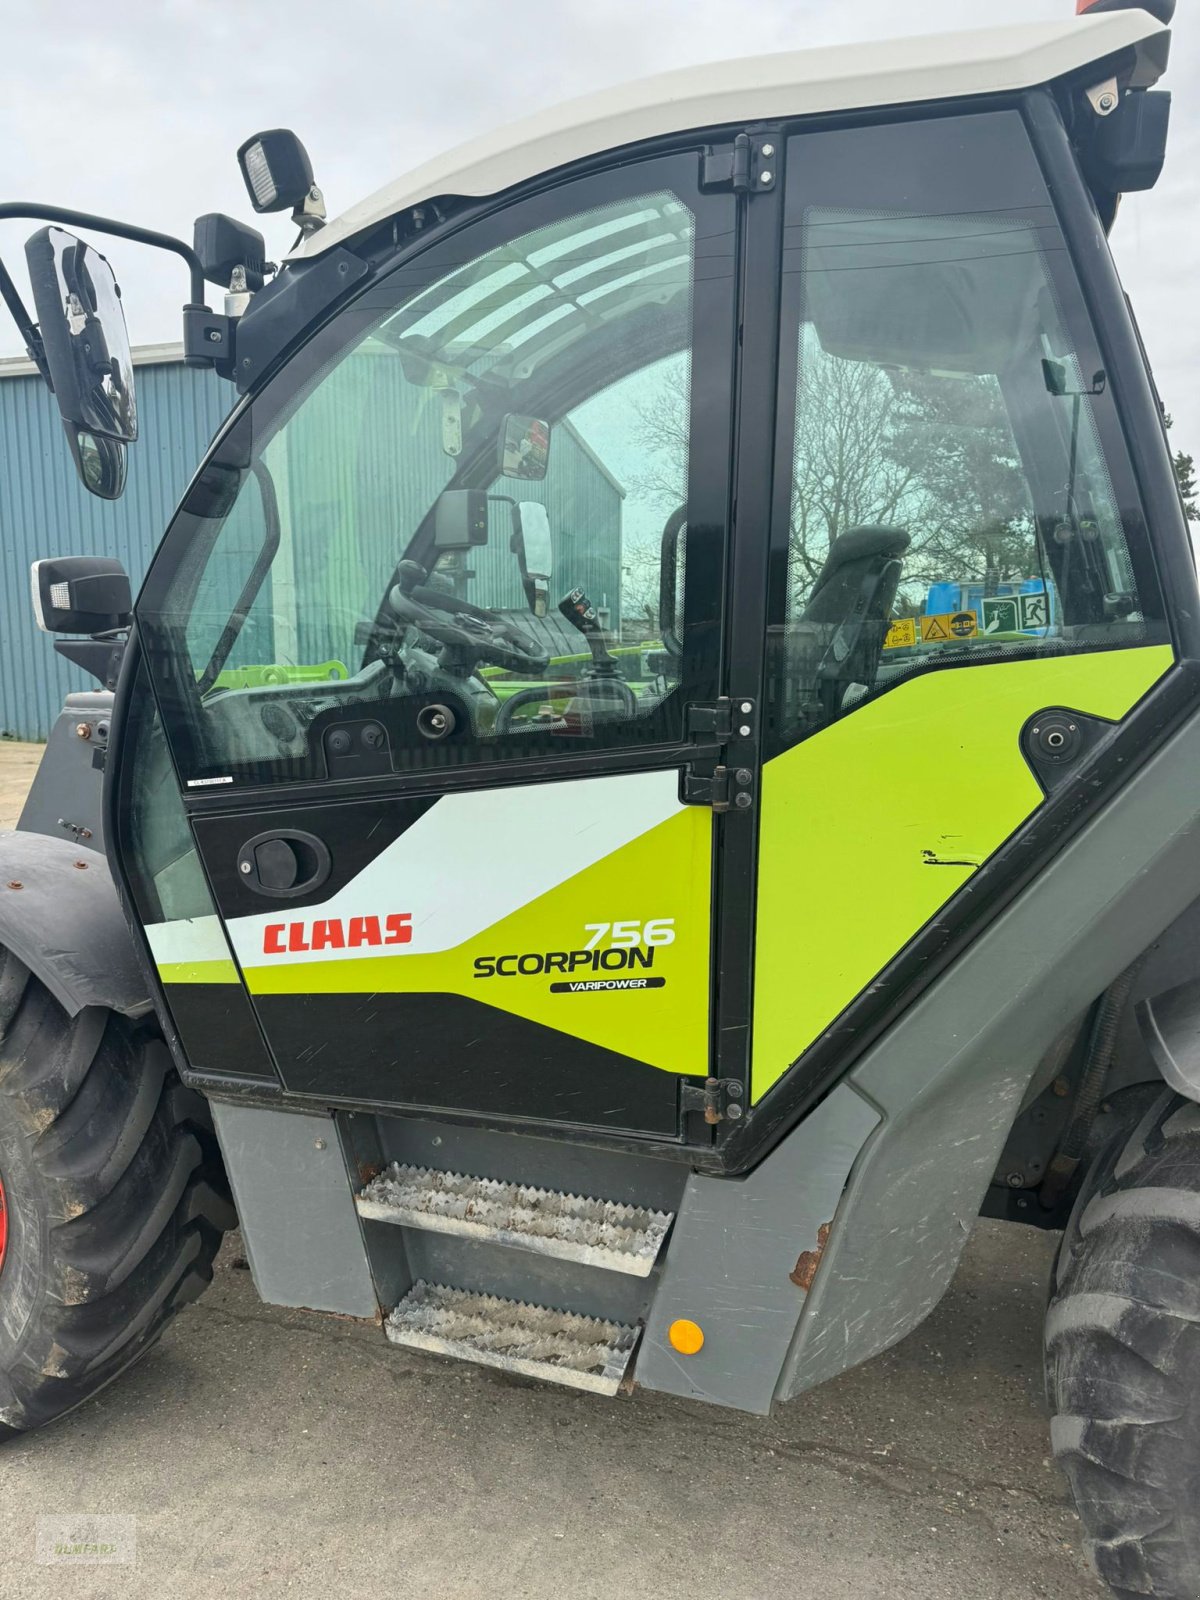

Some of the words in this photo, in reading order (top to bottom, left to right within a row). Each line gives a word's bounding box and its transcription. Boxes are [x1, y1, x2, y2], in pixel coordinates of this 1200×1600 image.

[264, 913, 412, 954] CLAAS
[584, 918, 675, 951] 756
[473, 946, 654, 978] SCORPION
[569, 978, 647, 991] VARIPOWER
